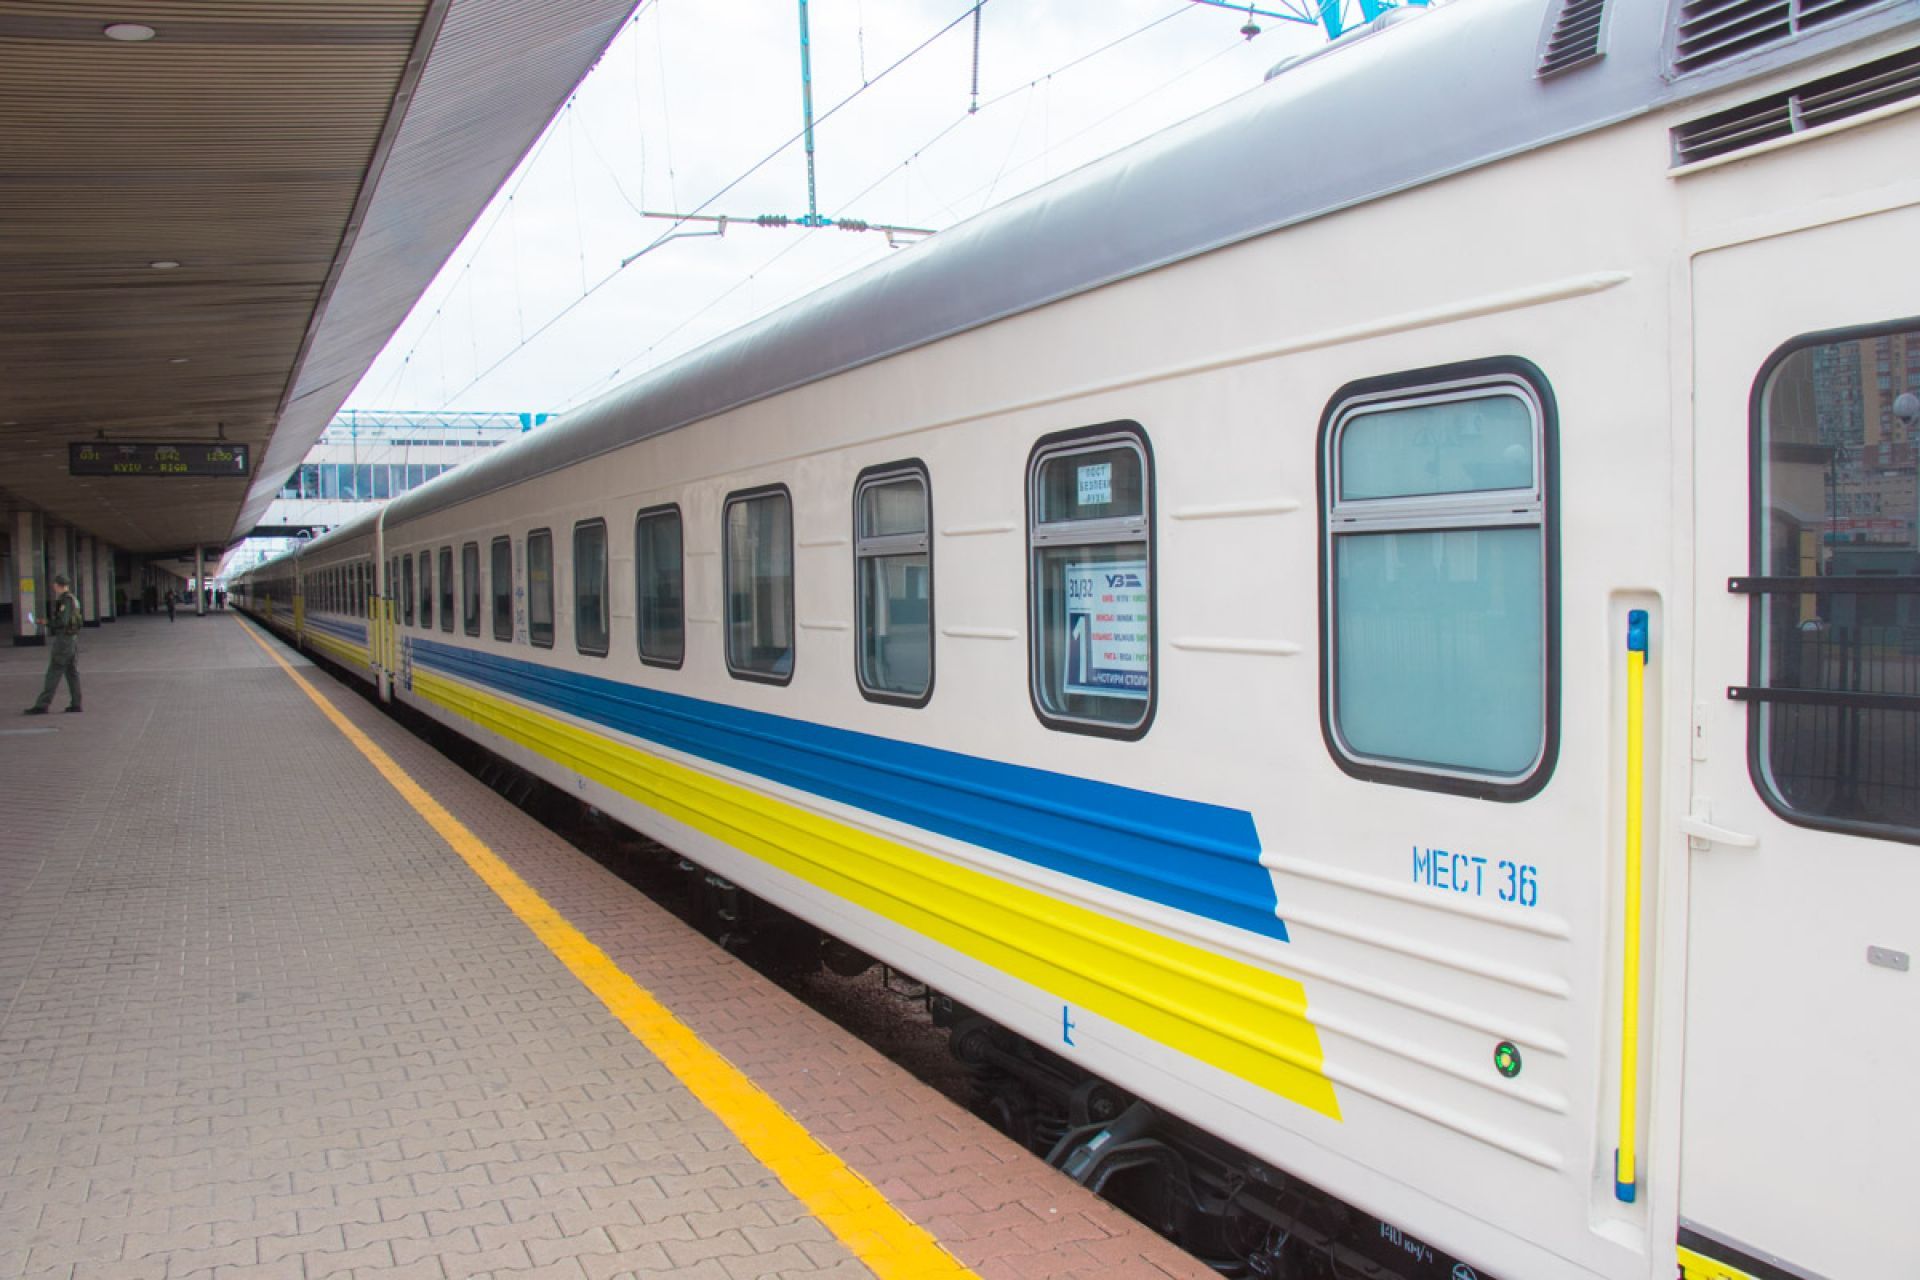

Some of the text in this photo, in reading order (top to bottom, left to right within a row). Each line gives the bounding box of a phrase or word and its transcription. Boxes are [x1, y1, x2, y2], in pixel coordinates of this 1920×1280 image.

[234, 455, 244, 470] 1
[1070, 578, 1094, 600] 31/32
[1072, 616, 1087, 683] 1
[1412, 845, 1538, 907] МЕСТ 36
[1379, 1222, 1403, 1247] 140
